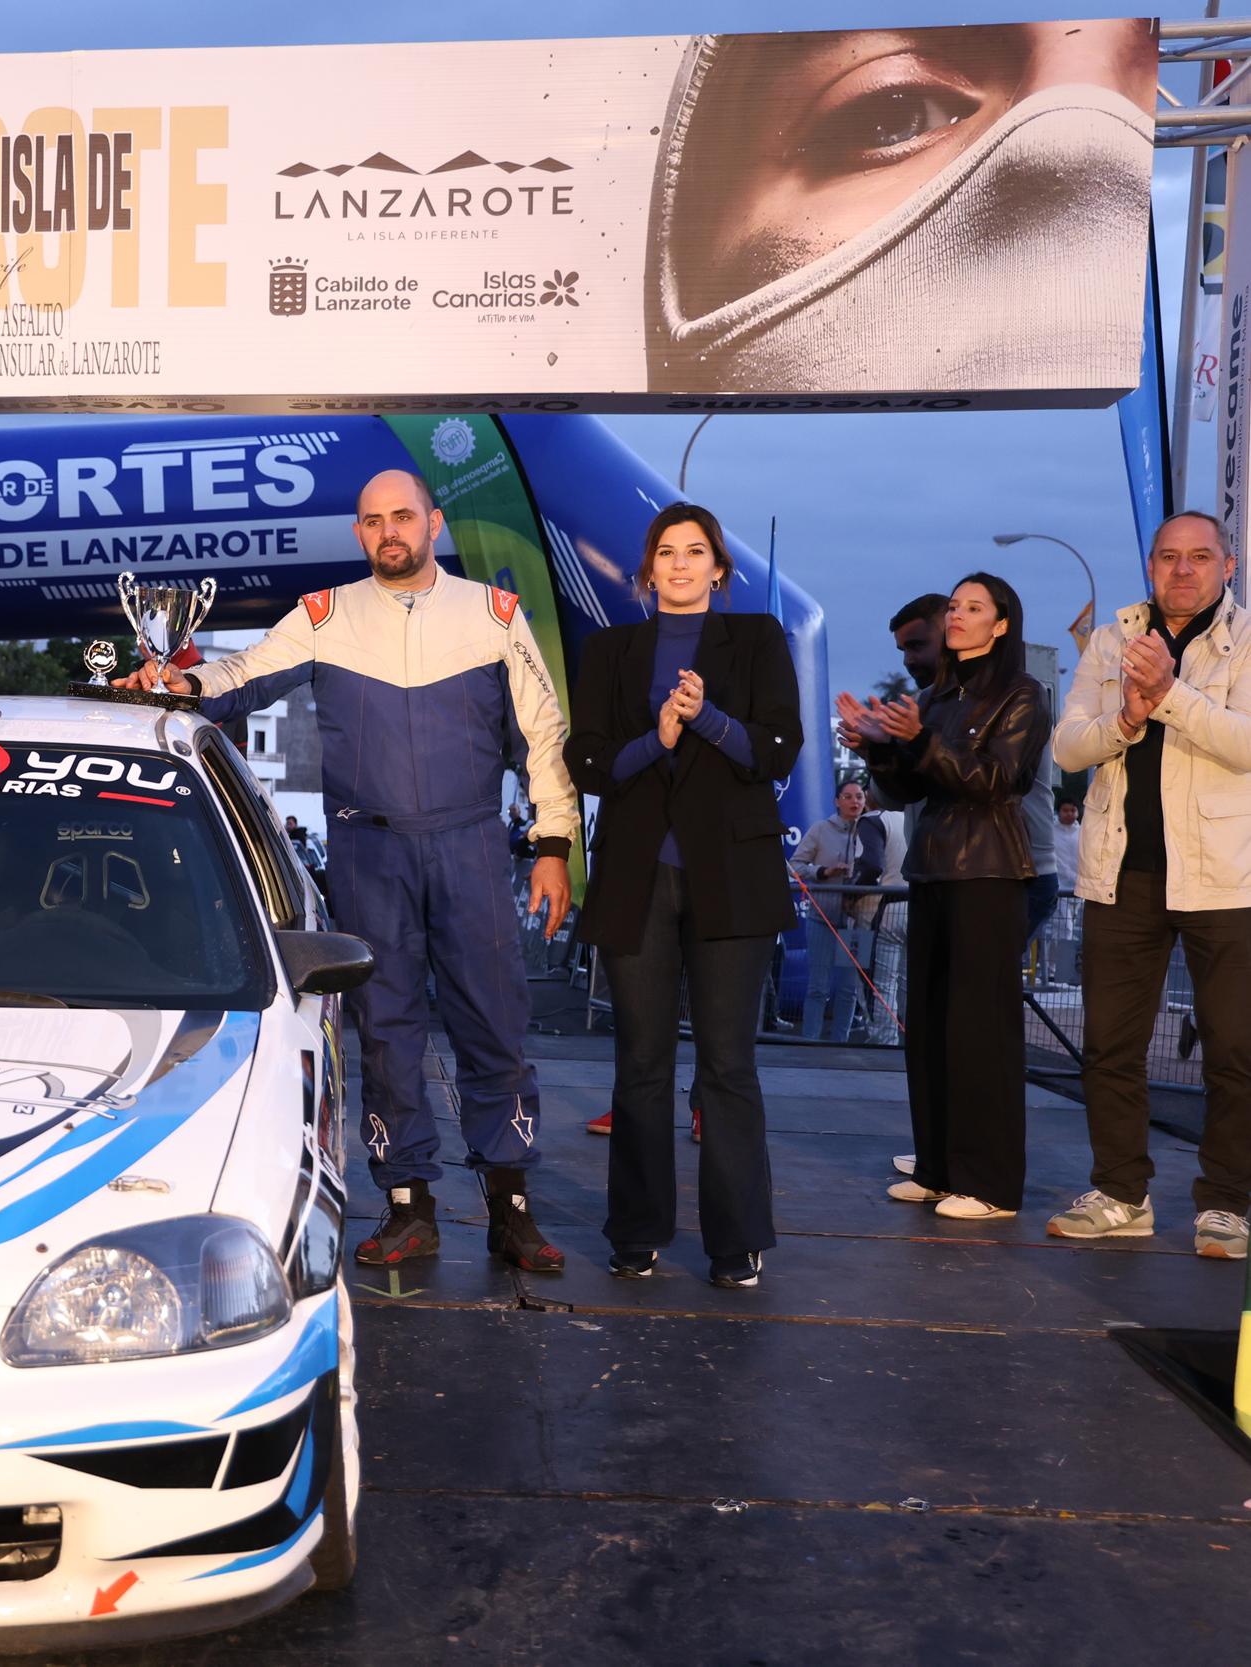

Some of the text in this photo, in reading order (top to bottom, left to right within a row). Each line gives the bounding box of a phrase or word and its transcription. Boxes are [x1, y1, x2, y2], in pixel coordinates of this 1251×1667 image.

[1, 133, 75, 233] ISLA
[87, 132, 132, 231] DE
[275, 186, 574, 219] LANZAROTE
[347, 230, 499, 241] LA ISLA DIFERENTE
[315, 276, 418, 292] Cabildo de
[483, 271, 536, 289] Islas
[315, 295, 411, 311] Lanzarote
[432, 290, 536, 308] Canarias
[1, 302, 63, 337] ASFALTO
[519, 314, 535, 323] VIDA
[59, 350, 69, 376] de
[72, 341, 161, 375] LANZAROTE
[24, 478, 54, 496] DE
[60, 527, 298, 567] LANZAROTE
[58, 820, 133, 841] sparco
